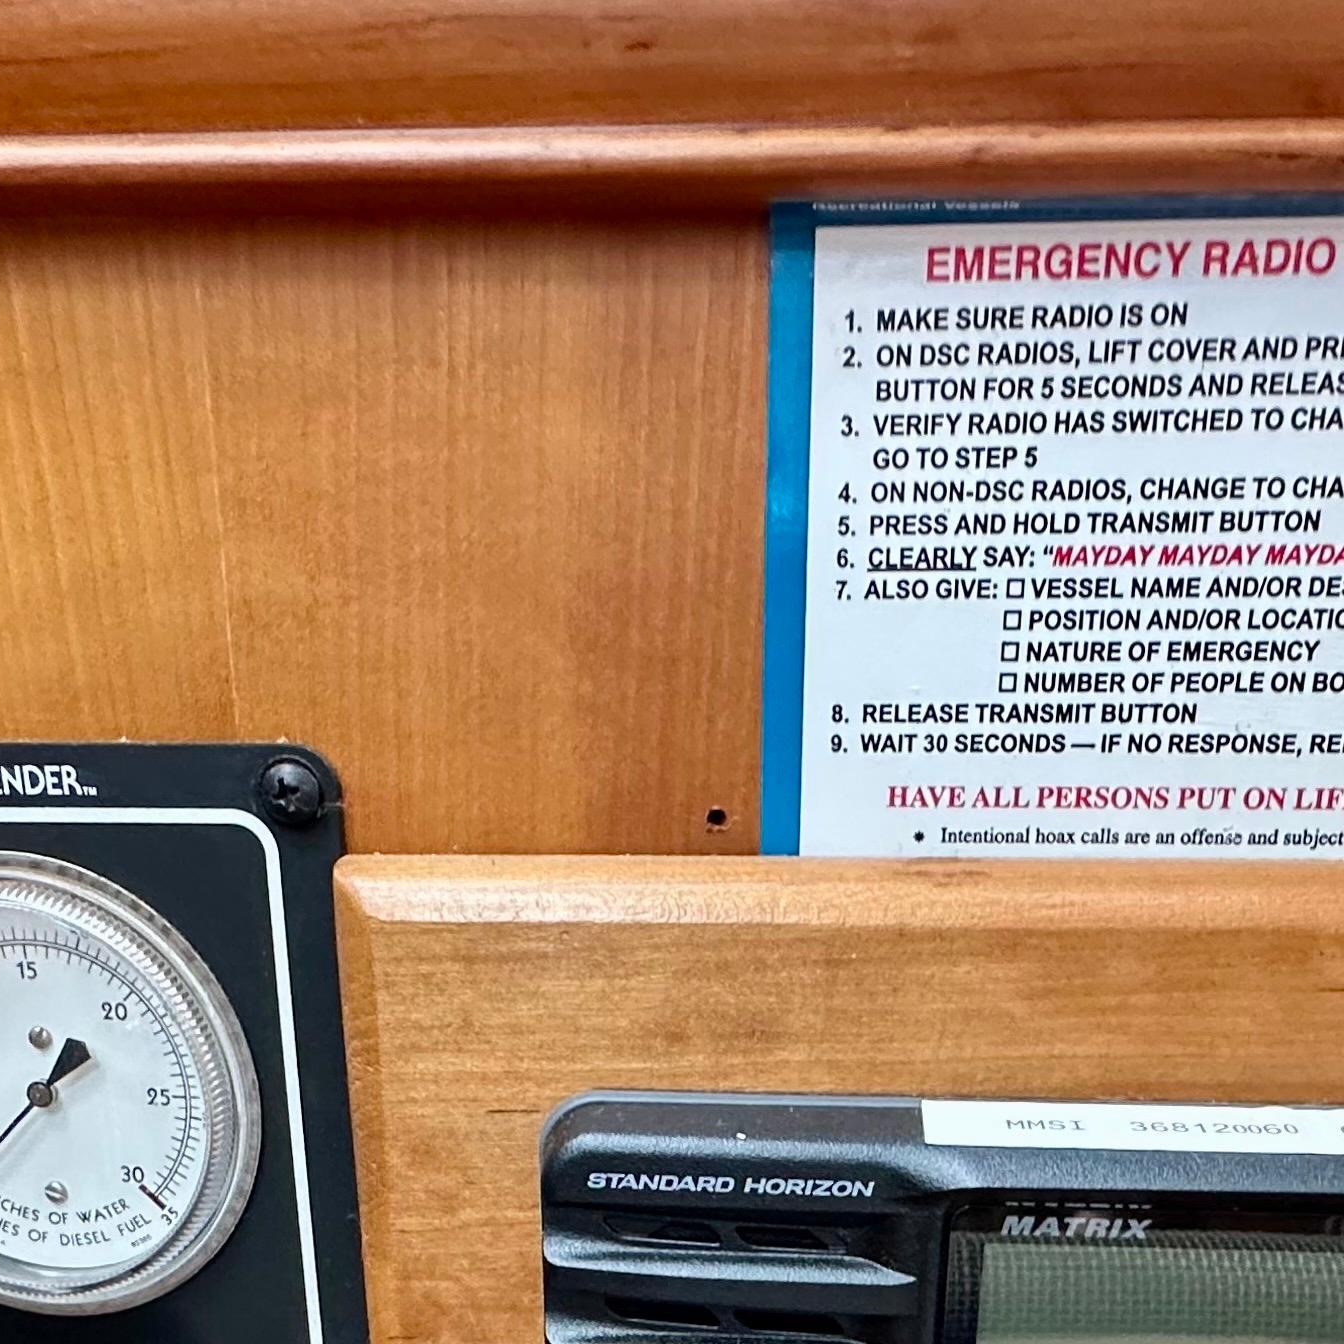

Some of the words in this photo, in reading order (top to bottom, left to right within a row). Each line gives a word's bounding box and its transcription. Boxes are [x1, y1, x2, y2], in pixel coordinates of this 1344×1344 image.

[927, 241, 1191, 281] EMERGENCY
[1203, 238, 1335, 275] RADIO
[877, 308, 948, 331] MAKE
[956, 306, 1024, 330] SURE
[1032, 304, 1113, 328] RADIO
[1120, 304, 1142, 327] IS
[1151, 303, 1188, 326] ON
[877, 344, 915, 367] ON
[920, 343, 969, 366] DSC
[978, 341, 1080, 368] RADIOS,
[1089, 340, 1142, 363] LIFT
[1148, 339, 1236, 362] COVER
[1242, 337, 1297, 361] AND
[867, 546, 977, 572] CLEARLY
[983, 546, 1034, 567] SAY:
[1158, 544, 1262, 565] MAYDAY
[864, 579, 928, 599] ALSO
[936, 579, 997, 599] GIVE:
[1031, 578, 1123, 599] VESSEL
[1131, 577, 1201, 598] NAME
[1206, 577, 1301, 598] AND/OR
[861, 734, 917, 752] WAIT
[924, 734, 947, 752] 30
[955, 734, 1065, 753] SECONDS
[1101, 734, 1122, 753] IF
[1128, 734, 1161, 753] NO
[1168, 734, 1301, 757] RESPONSE,
[889, 786, 965, 808] HAVE
[972, 787, 1030, 808] ALL
[1037, 786, 1169, 809] PERSONS
[1178, 788, 1230, 809] PUT
[1244, 788, 1287, 810] ON
[942, 827, 1029, 844] Intentional
[1036, 828, 1075, 844] hoax
[1081, 828, 1119, 844] calls
[1181, 828, 1242, 845] offense
[1248, 829, 1278, 845] and
[1283, 829, 1343, 850] subject
[17, 961, 37, 979] 15
[102, 1002, 127, 1021] 20
[147, 1088, 170, 1106] 25
[1006, 1120, 1084, 1130] MMSI
[1130, 1122, 1298, 1134] 368120060
[121, 1166, 144, 1183] 30
[587, 1173, 734, 1192] STANDARD
[744, 1178, 875, 1197] HORIZON
[48, 1212, 68, 1225] OF
[76, 1199, 129, 1223] WATER
[28, 1229, 48, 1243] OF
[60, 1231, 111, 1246] DIESEL
[117, 1214, 152, 1236] FUEL
[1001, 1216, 1153, 1242] MATRIX
